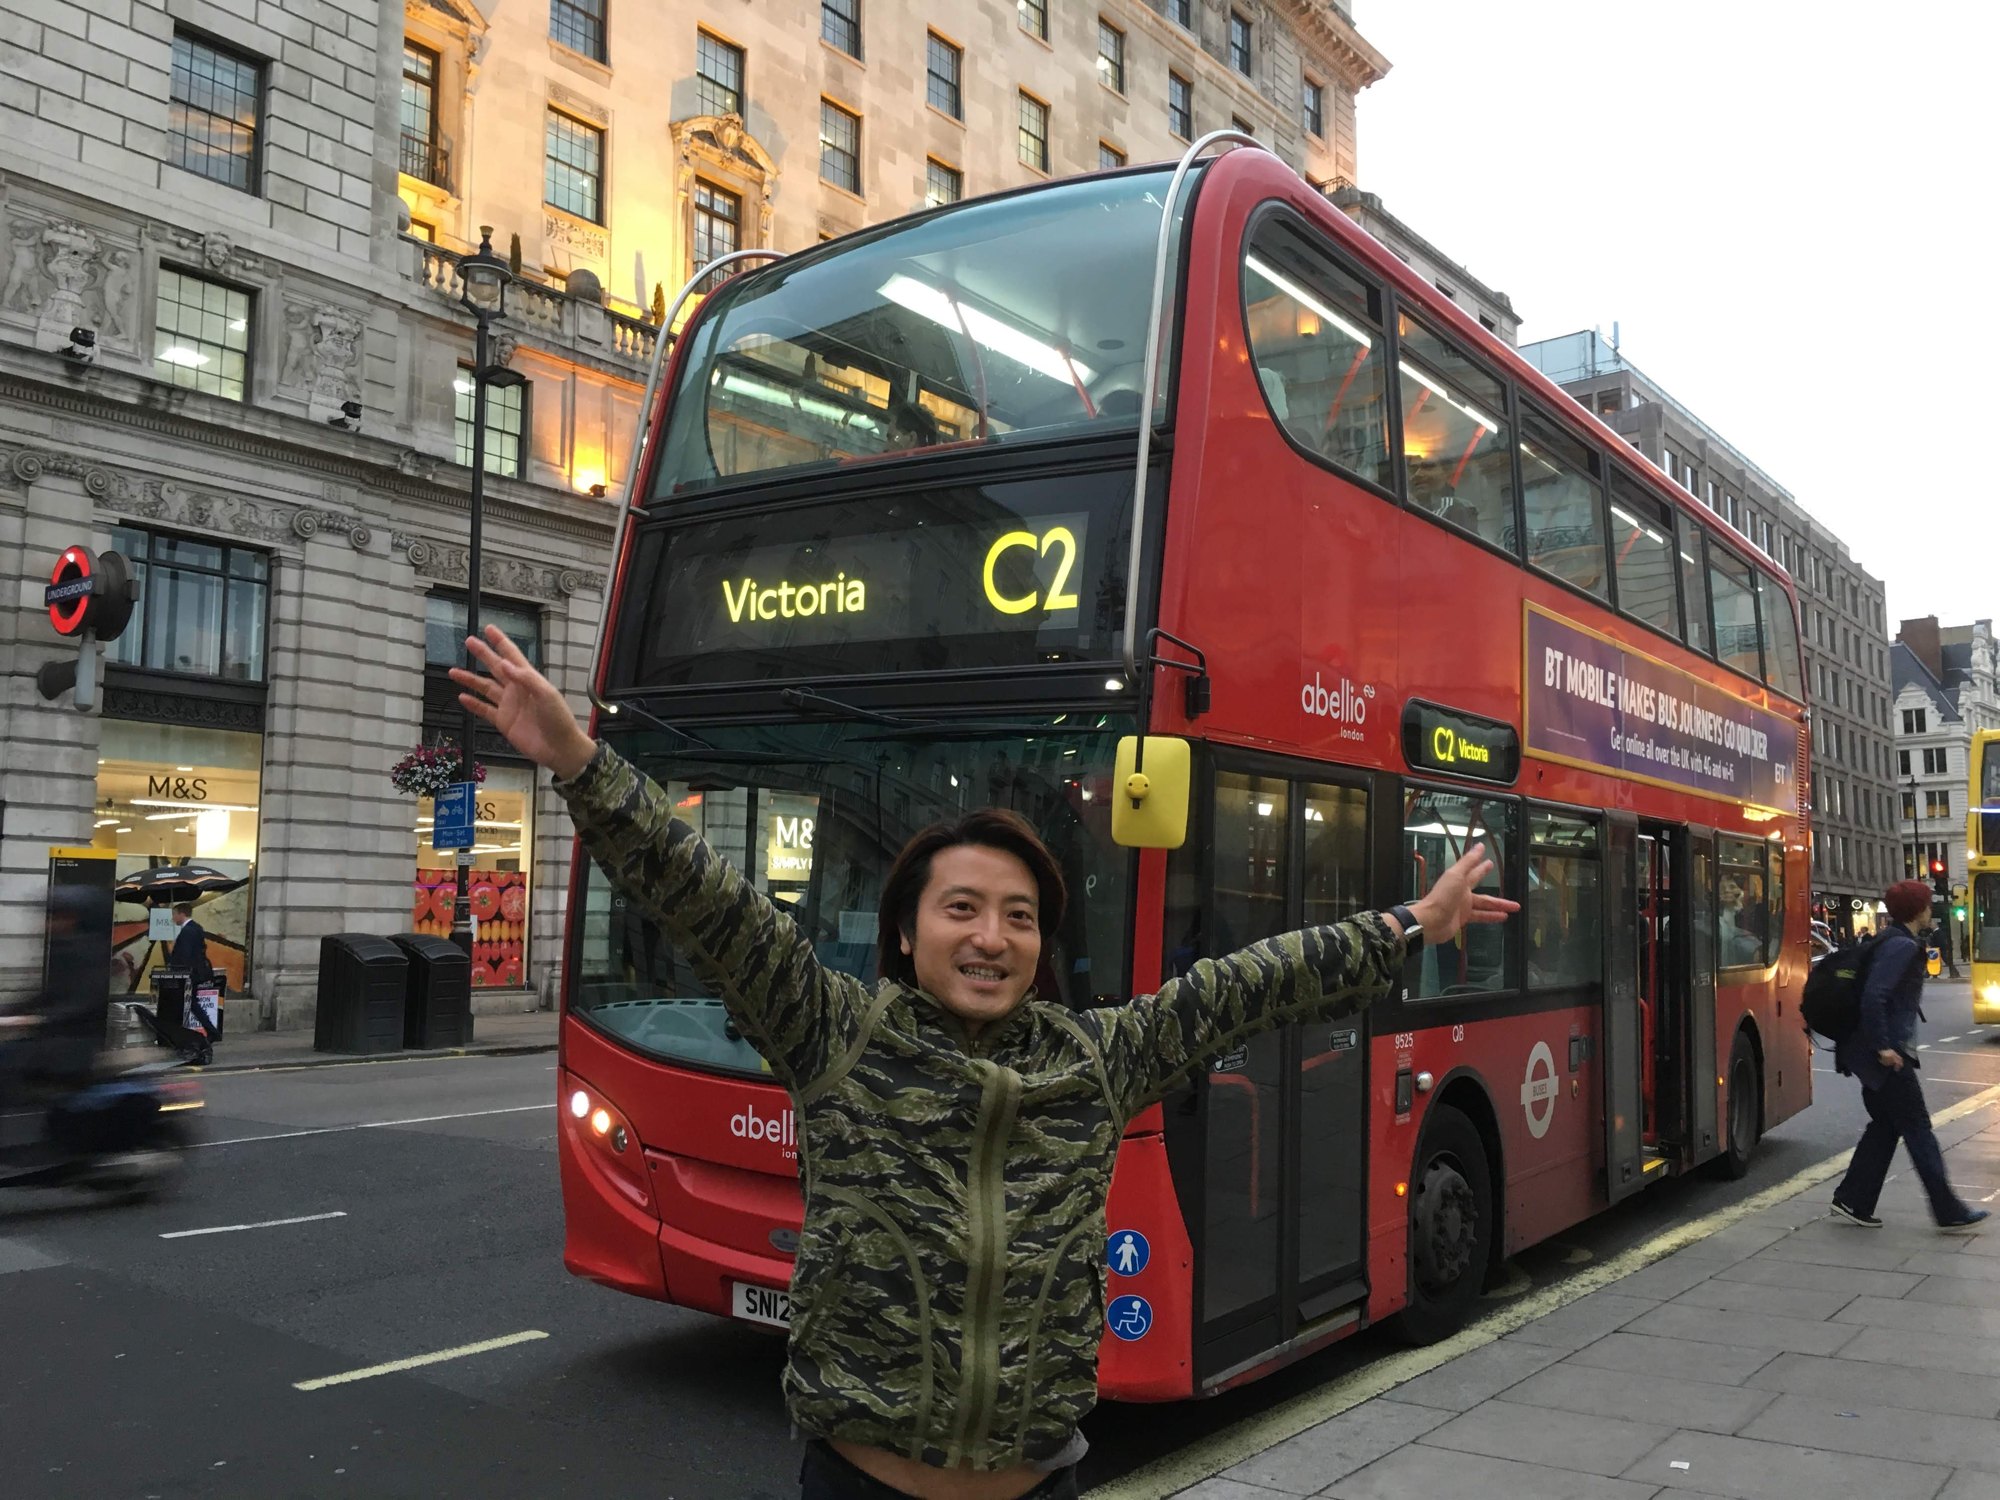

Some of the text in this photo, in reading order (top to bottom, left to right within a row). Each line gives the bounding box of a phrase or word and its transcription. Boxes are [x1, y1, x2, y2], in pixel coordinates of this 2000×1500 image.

[983, 526, 1078, 615] C2
[47, 580, 93, 600] UNDERGROUND
[722, 572, 865, 623] Victoria
[1302, 671, 1365, 725] abellio
[1545, 646, 1563, 690] BT
[1566, 655, 1616, 709] MOBILE
[1618, 675, 1655, 723] MAKES
[1658, 692, 1677, 730] BUS
[1679, 701, 1723, 746] JOURNEYS
[1724, 719, 1736, 750] GO
[1340, 726, 1364, 741] london
[1434, 727, 1490, 763] C2 Victoria
[1625, 732, 1646, 758] online
[1646, 738, 1655, 761] all
[1655, 746, 1670, 764] over
[1670, 745, 1681, 768] the
[1681, 747, 1691, 770] UK
[1703, 755, 1712, 776] 4G
[148, 775, 207, 801] M&S
[1774, 762, 1786, 785] BT
[1395, 1033, 1414, 1049] 9525
[1452, 1025, 1464, 1043] QB
[730, 1104, 799, 1147] abell
